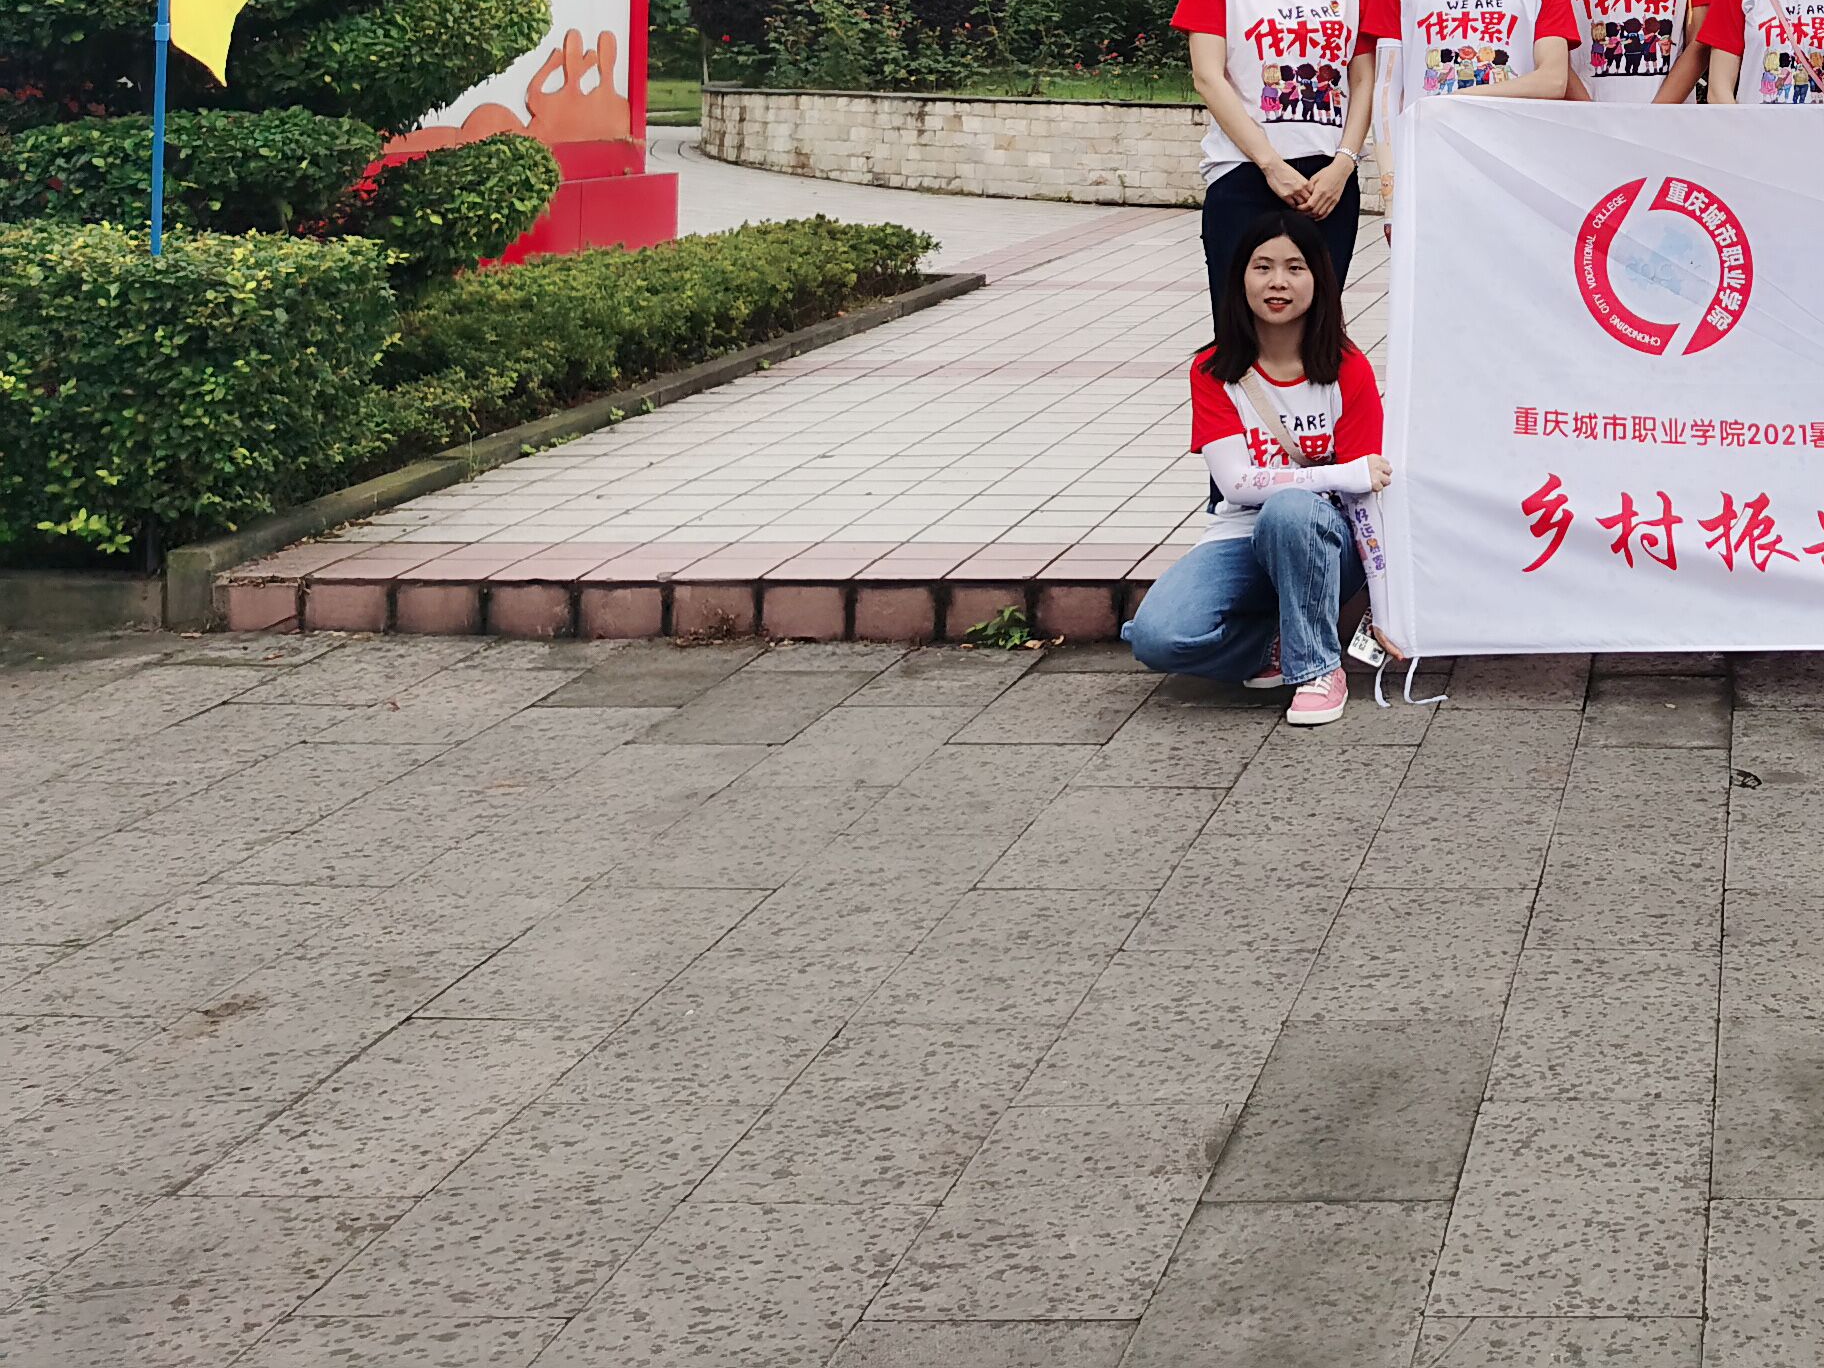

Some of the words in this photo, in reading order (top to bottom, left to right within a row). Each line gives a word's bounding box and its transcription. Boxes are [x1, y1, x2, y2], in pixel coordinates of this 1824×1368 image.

[1278, 6, 1305, 21] WE
[1311, 4, 1341, 19] ARE
[1446, 0, 1469, 10] WE
[1244, 17, 1352, 67] 伐木累!
[1417, 10, 1519, 46] 伐木累!
[1592, 193, 1627, 229] COLLEGE
[1583, 234, 1597, 289] VOCATIONAL
[1666, 180, 1746, 331] 重庆城市职业学院
[1592, 293, 1610, 314] CITY
[1609, 314, 1661, 347] CHONGQING
[1293, 412, 1327, 432] ARE
